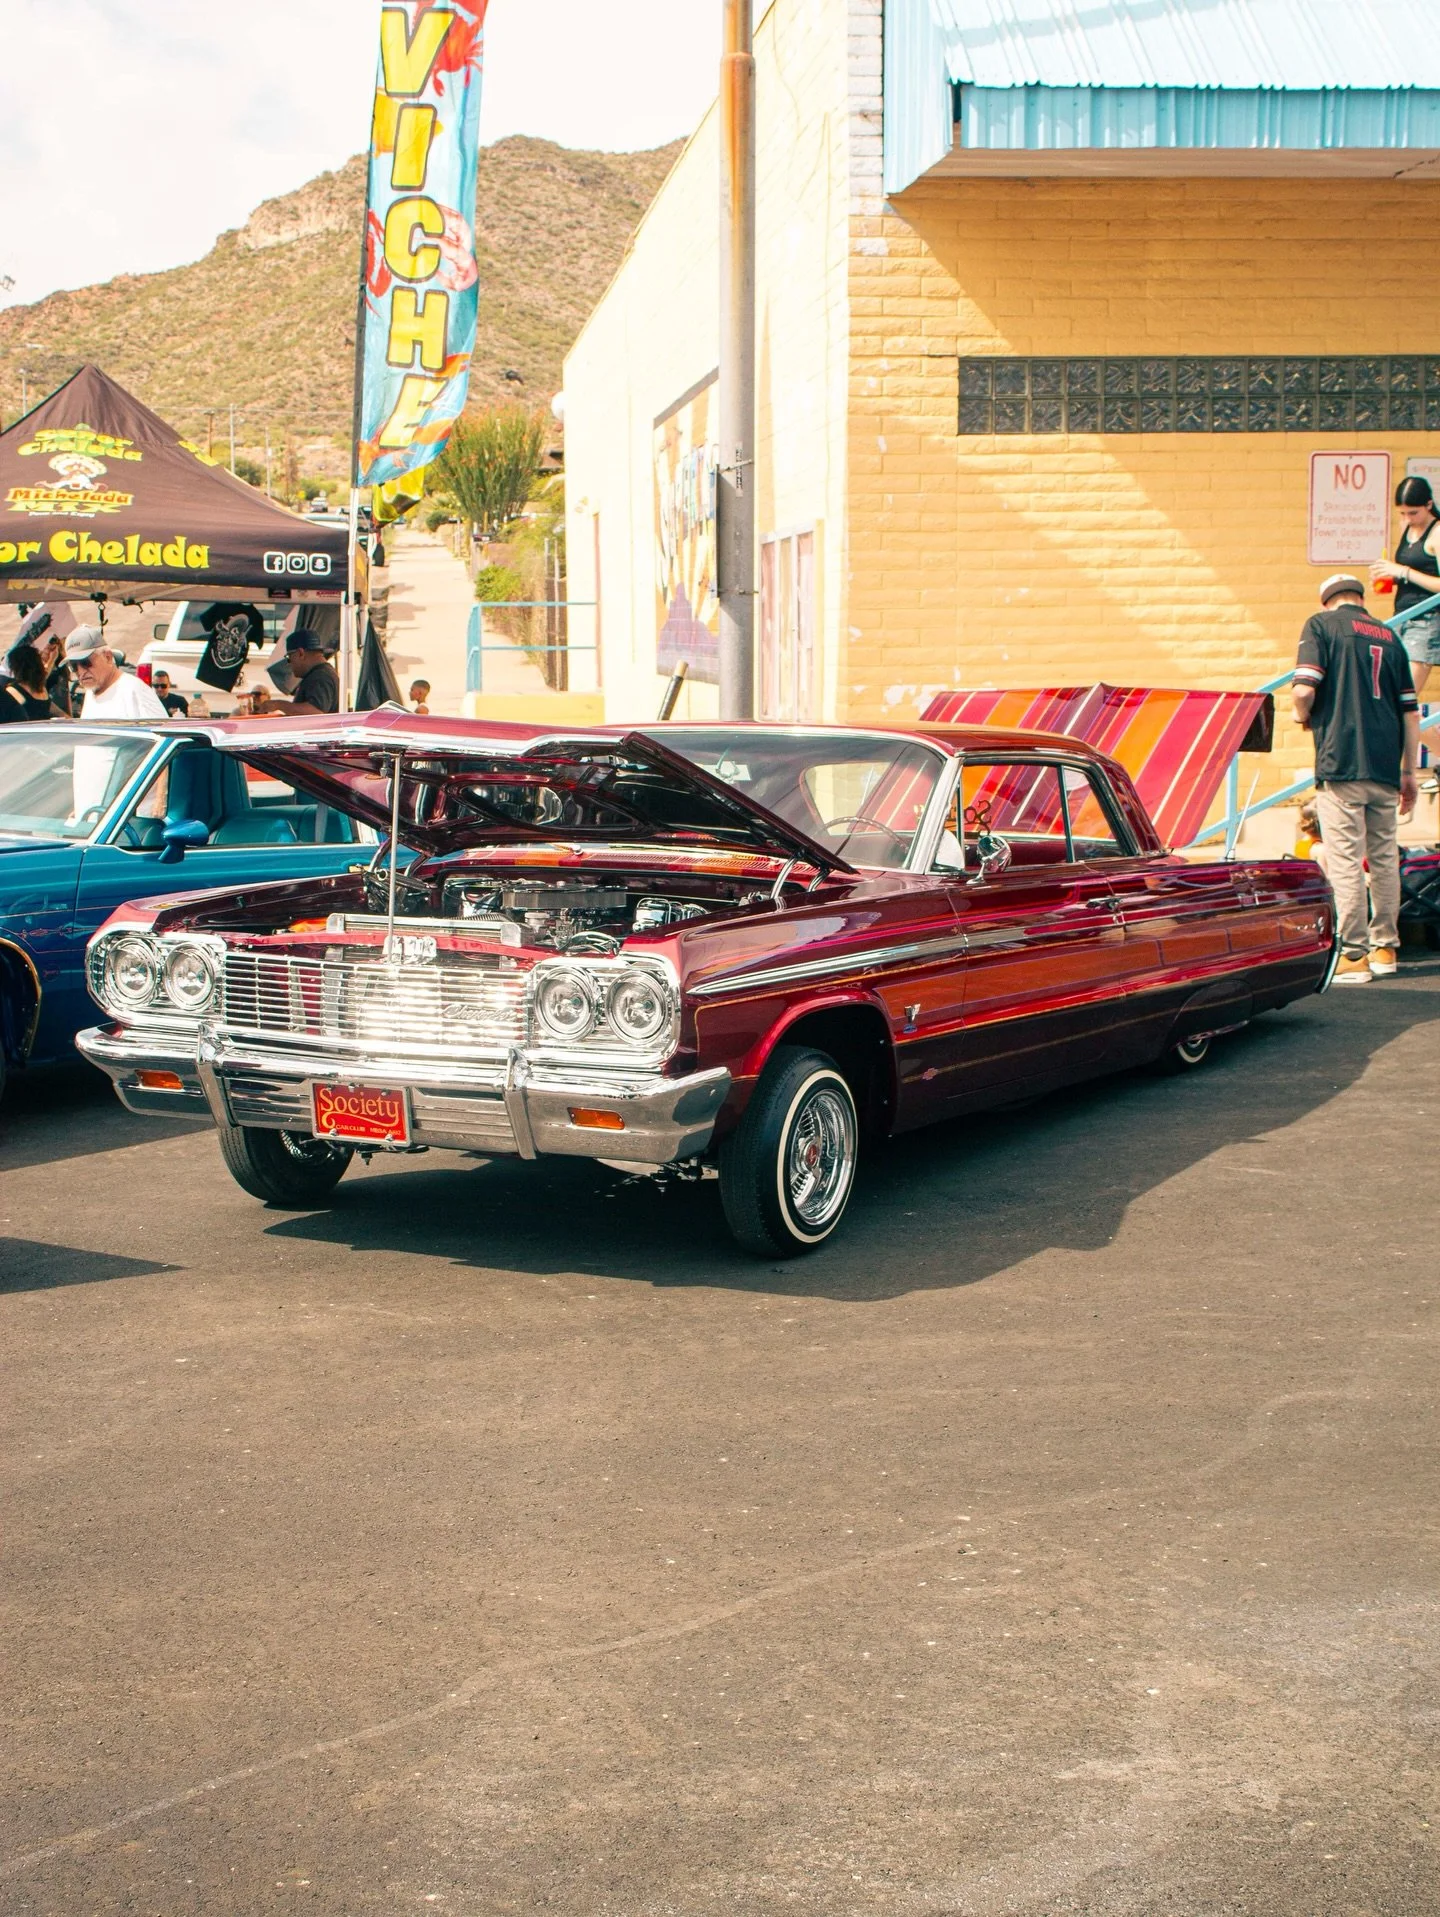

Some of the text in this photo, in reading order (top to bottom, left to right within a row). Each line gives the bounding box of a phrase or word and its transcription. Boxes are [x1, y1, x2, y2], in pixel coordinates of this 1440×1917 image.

[1335, 464, 1366, 490] NO
[8, 488, 133, 505] Michelada
[49, 530, 210, 569] Chelada
[1351, 619, 1393, 642] MURRAY
[1369, 644, 1383, 700] 1
[319, 1087, 400, 1128] Society
